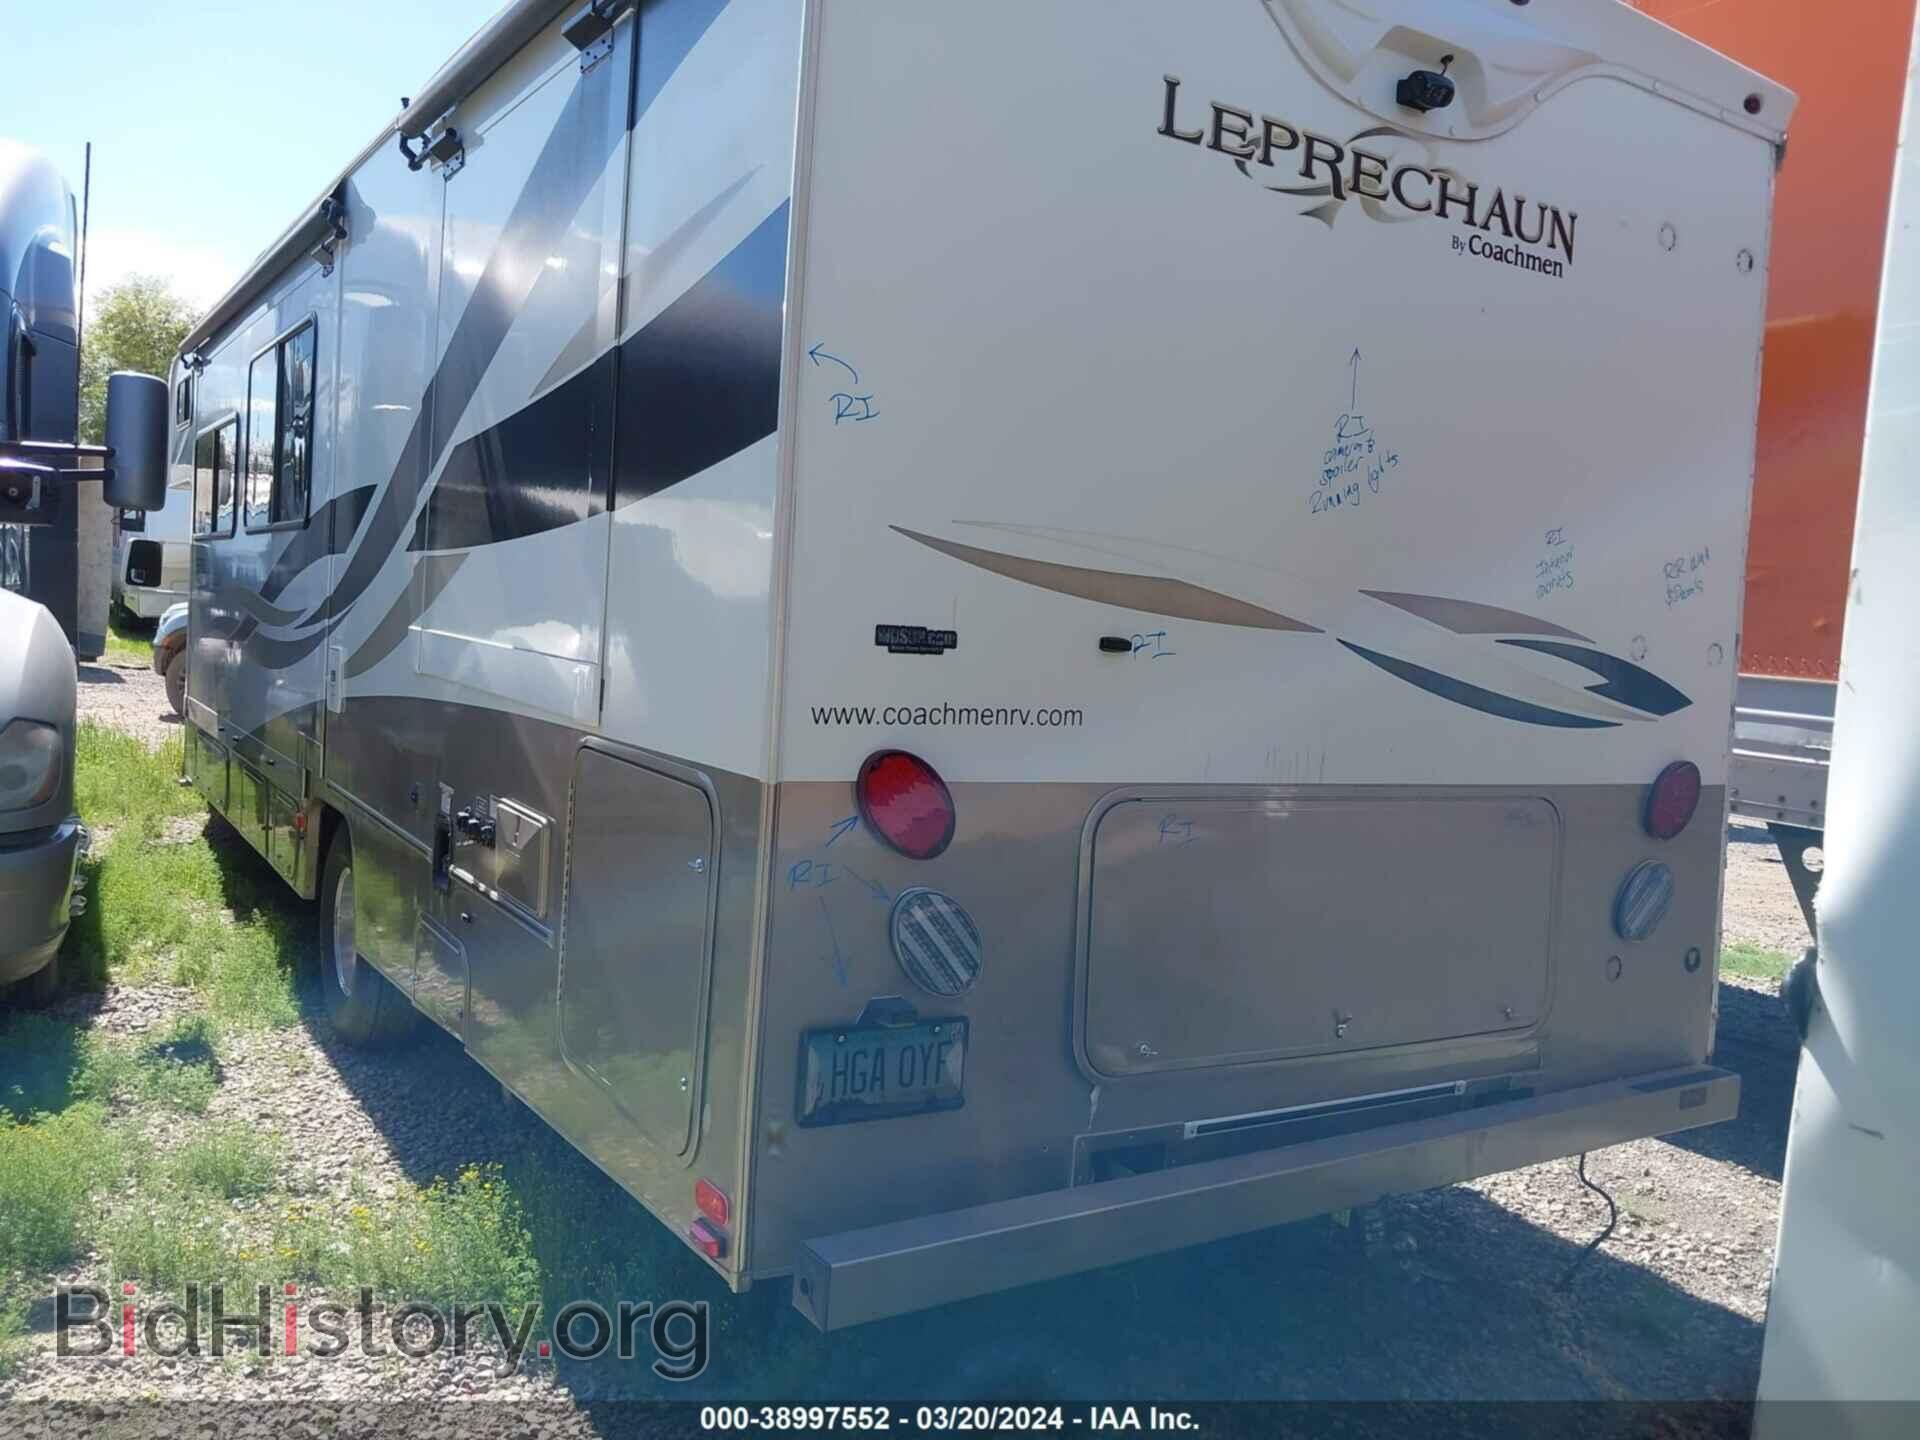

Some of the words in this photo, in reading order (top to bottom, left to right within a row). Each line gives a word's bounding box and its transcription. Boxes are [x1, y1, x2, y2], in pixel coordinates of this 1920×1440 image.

[1157, 74, 1577, 265] LEPRECHAUN
[1451, 235, 1467, 256] By
[1468, 234, 1564, 278] Coachmen
[811, 702, 1083, 727] www.coachmenrv.com
[832, 1047, 885, 1097] HGA
